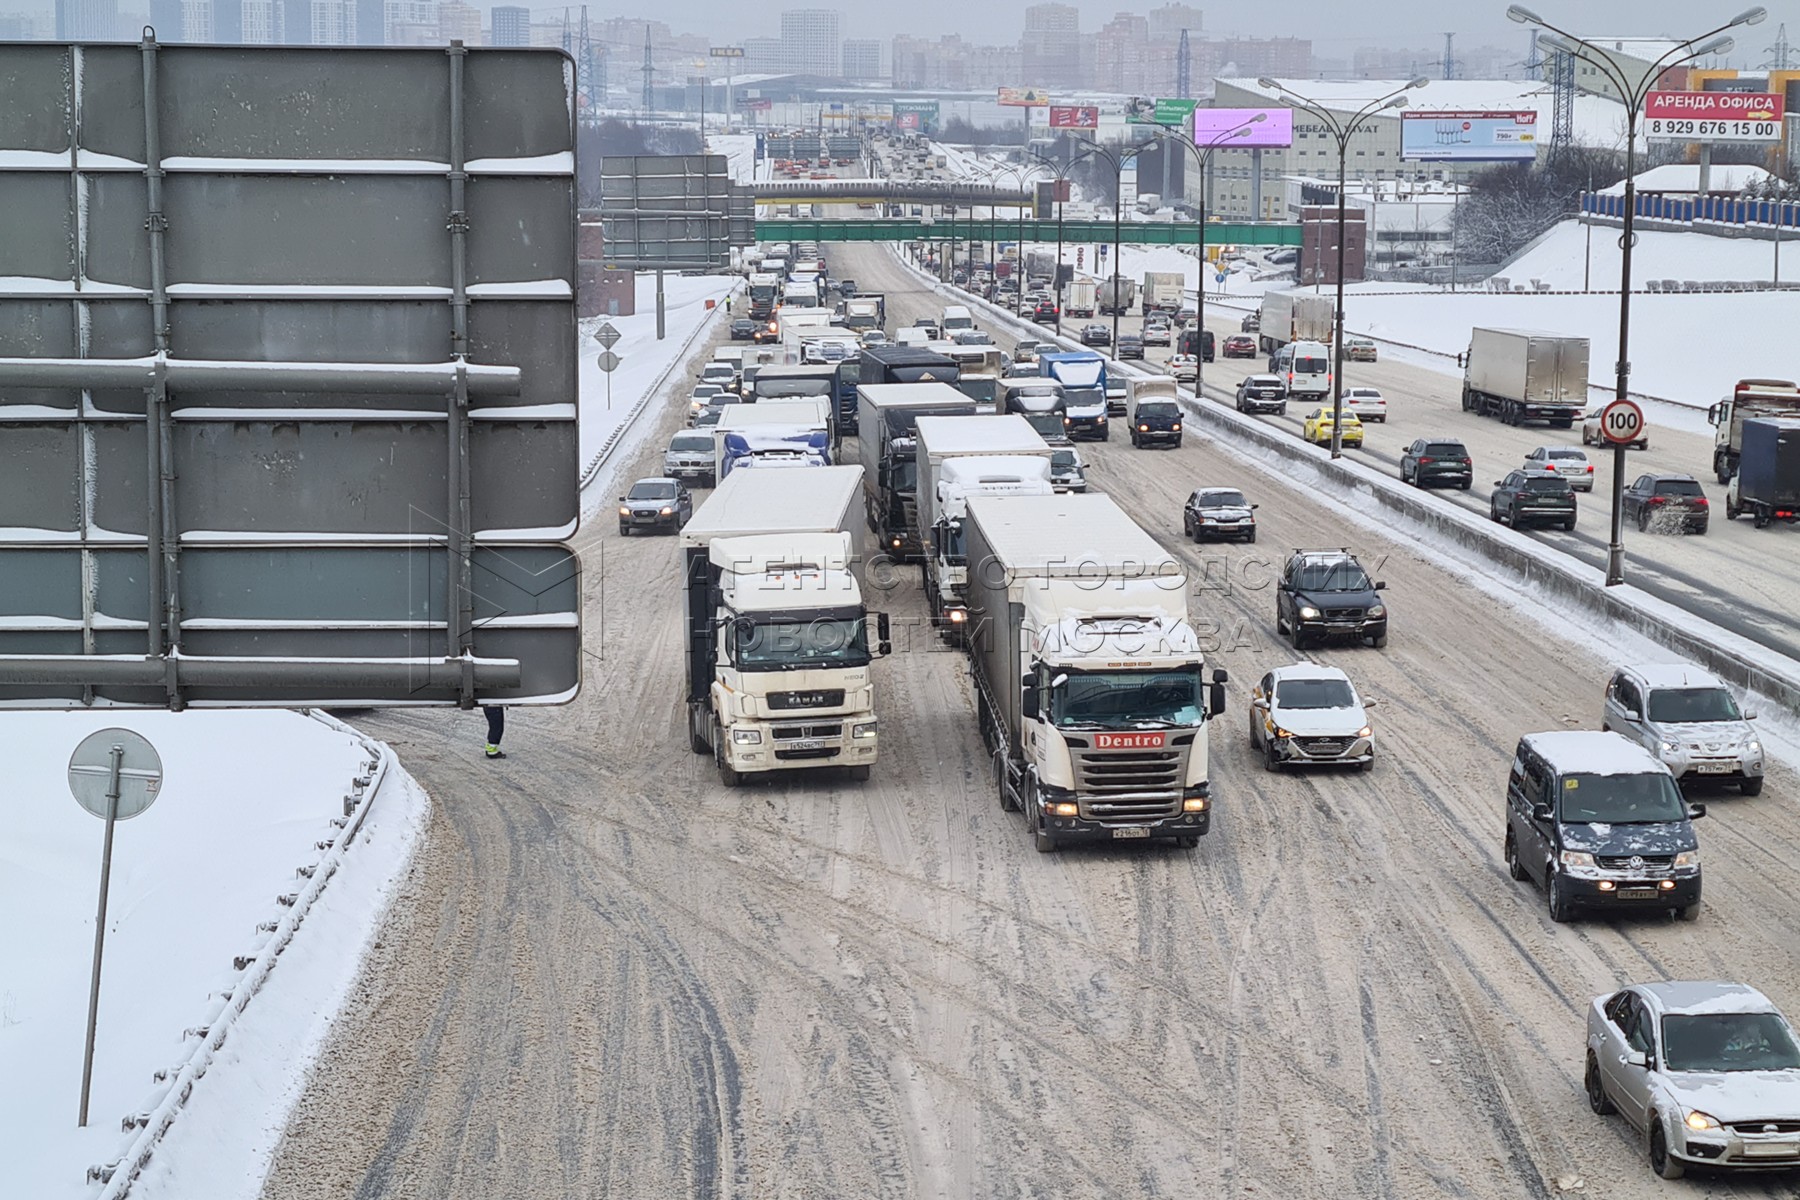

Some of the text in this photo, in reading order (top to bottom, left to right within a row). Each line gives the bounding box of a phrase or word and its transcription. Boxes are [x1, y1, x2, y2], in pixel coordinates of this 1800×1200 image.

[1654, 95, 1775, 110] АРЕНДА ОФИСА
[1516, 114, 1535, 123] Hoff
[1652, 120, 1774, 136] 8 929 676 15 00
[1608, 412, 1637, 430] 100
[1099, 735, 1162, 748] Dentro
